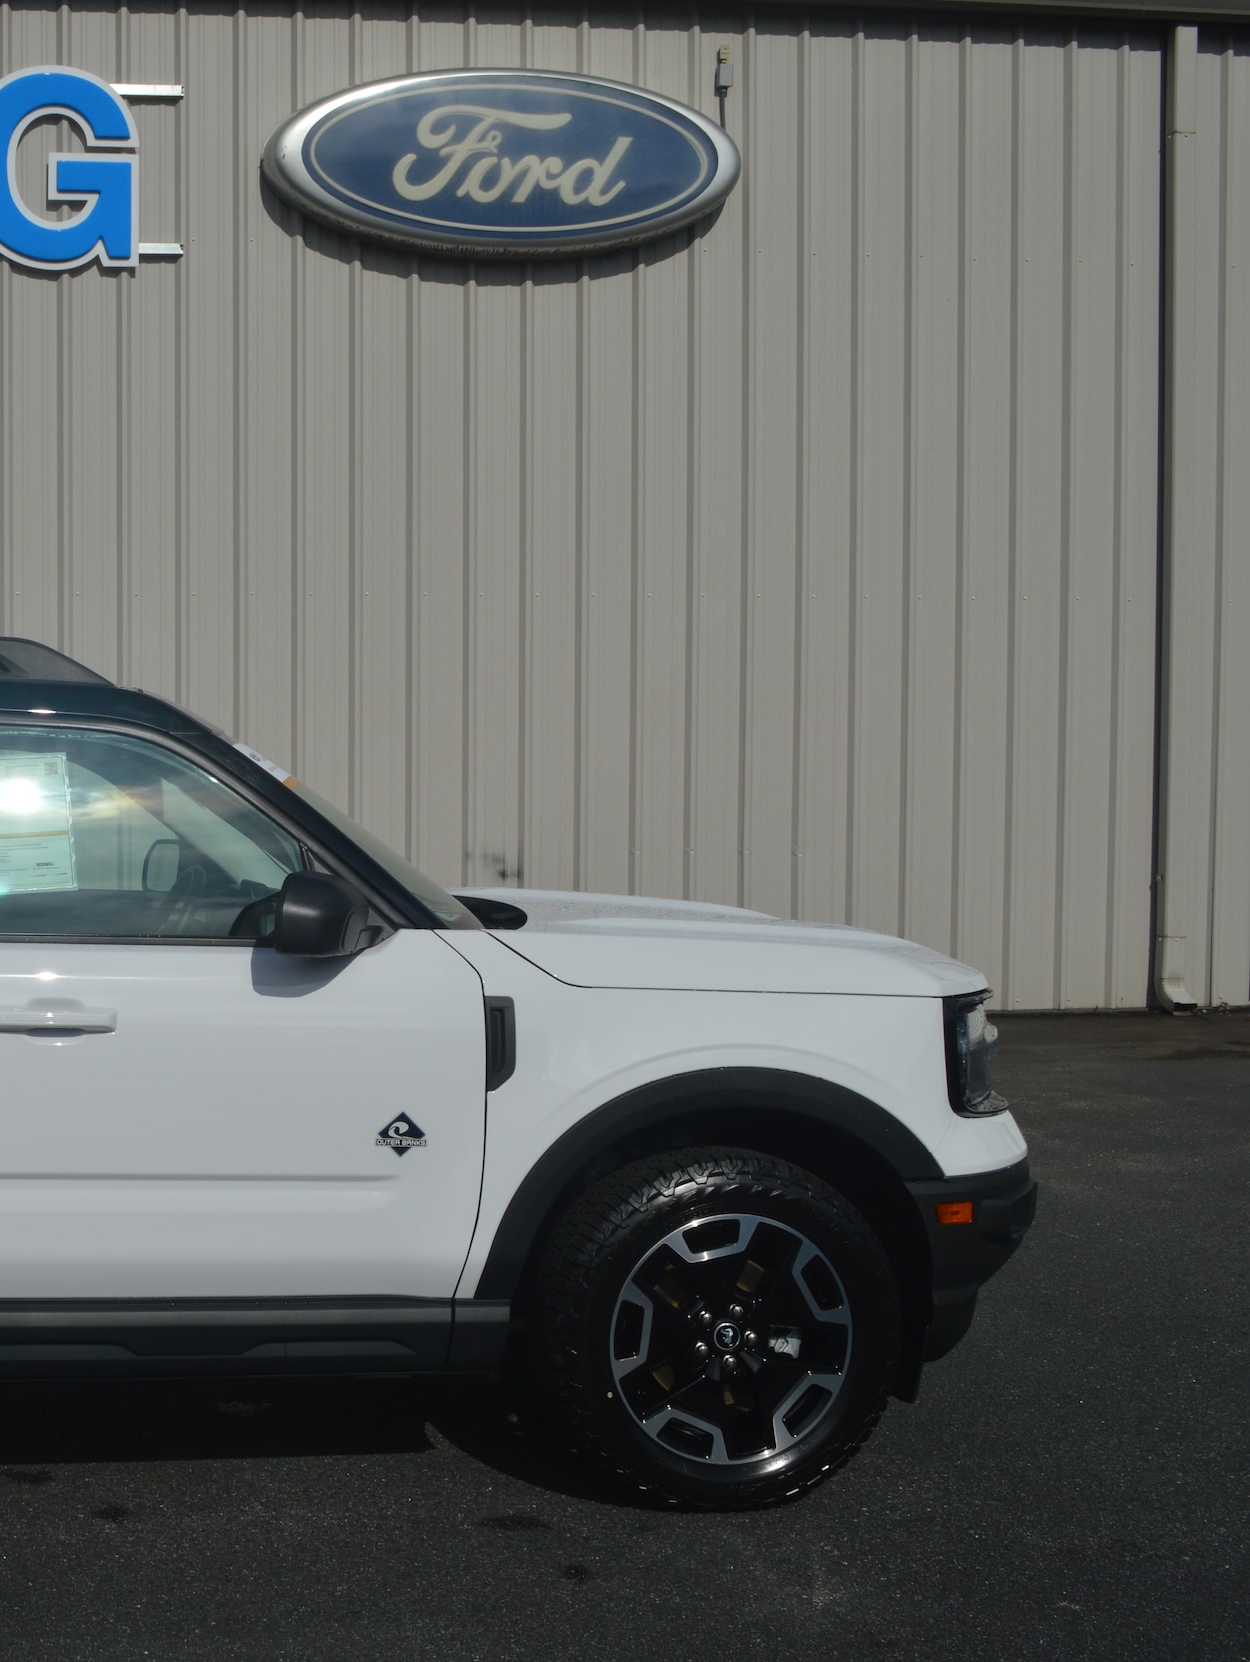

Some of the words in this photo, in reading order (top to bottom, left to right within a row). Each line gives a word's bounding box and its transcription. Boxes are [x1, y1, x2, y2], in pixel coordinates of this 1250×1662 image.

[392, 105, 633, 206] Ford
[376, 1138, 401, 1146] OUTER
[402, 1139, 426, 1147] BANKS
